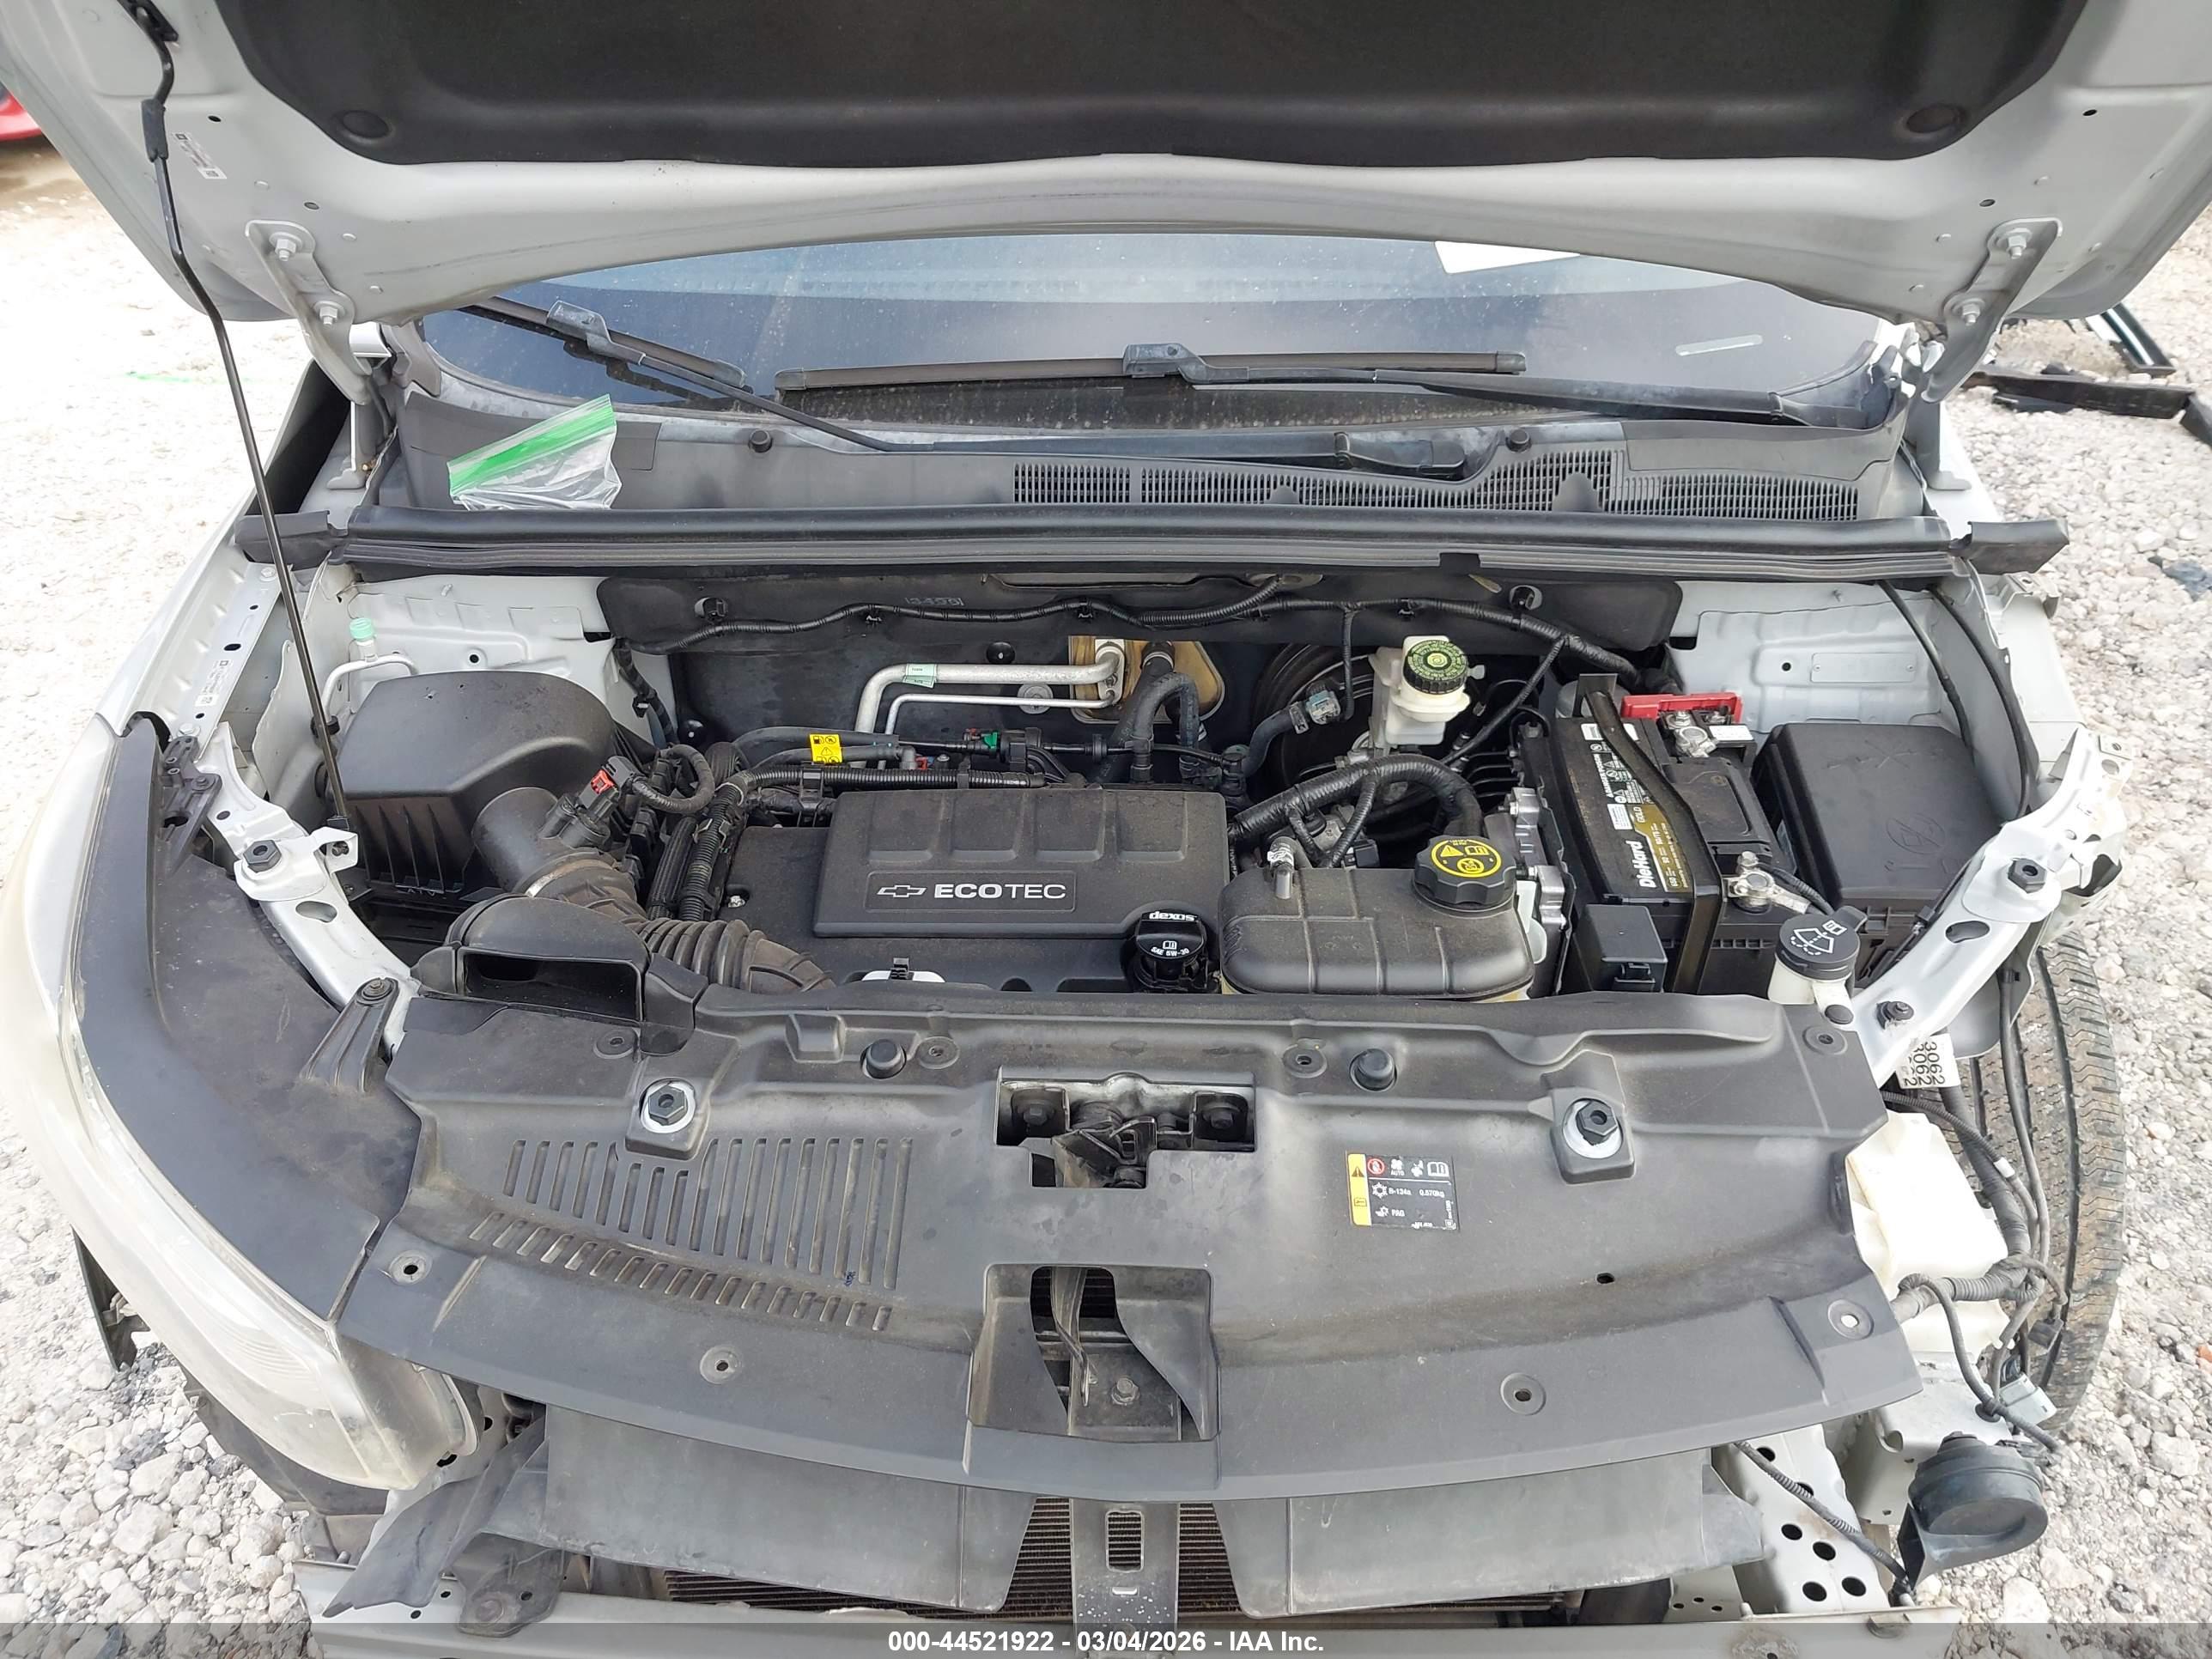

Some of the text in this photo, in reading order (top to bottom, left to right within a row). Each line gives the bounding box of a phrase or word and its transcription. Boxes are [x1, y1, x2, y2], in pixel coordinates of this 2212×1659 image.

[1633, 806, 1646, 823] GOLD
[1626, 840, 1657, 889] DieHard
[934, 883, 1066, 899] ECOTEC
[1149, 911, 1195, 921] dexos
[1151, 946, 1189, 957] SAE 5W-30
[1923, 1042, 1945, 1085] 3062
